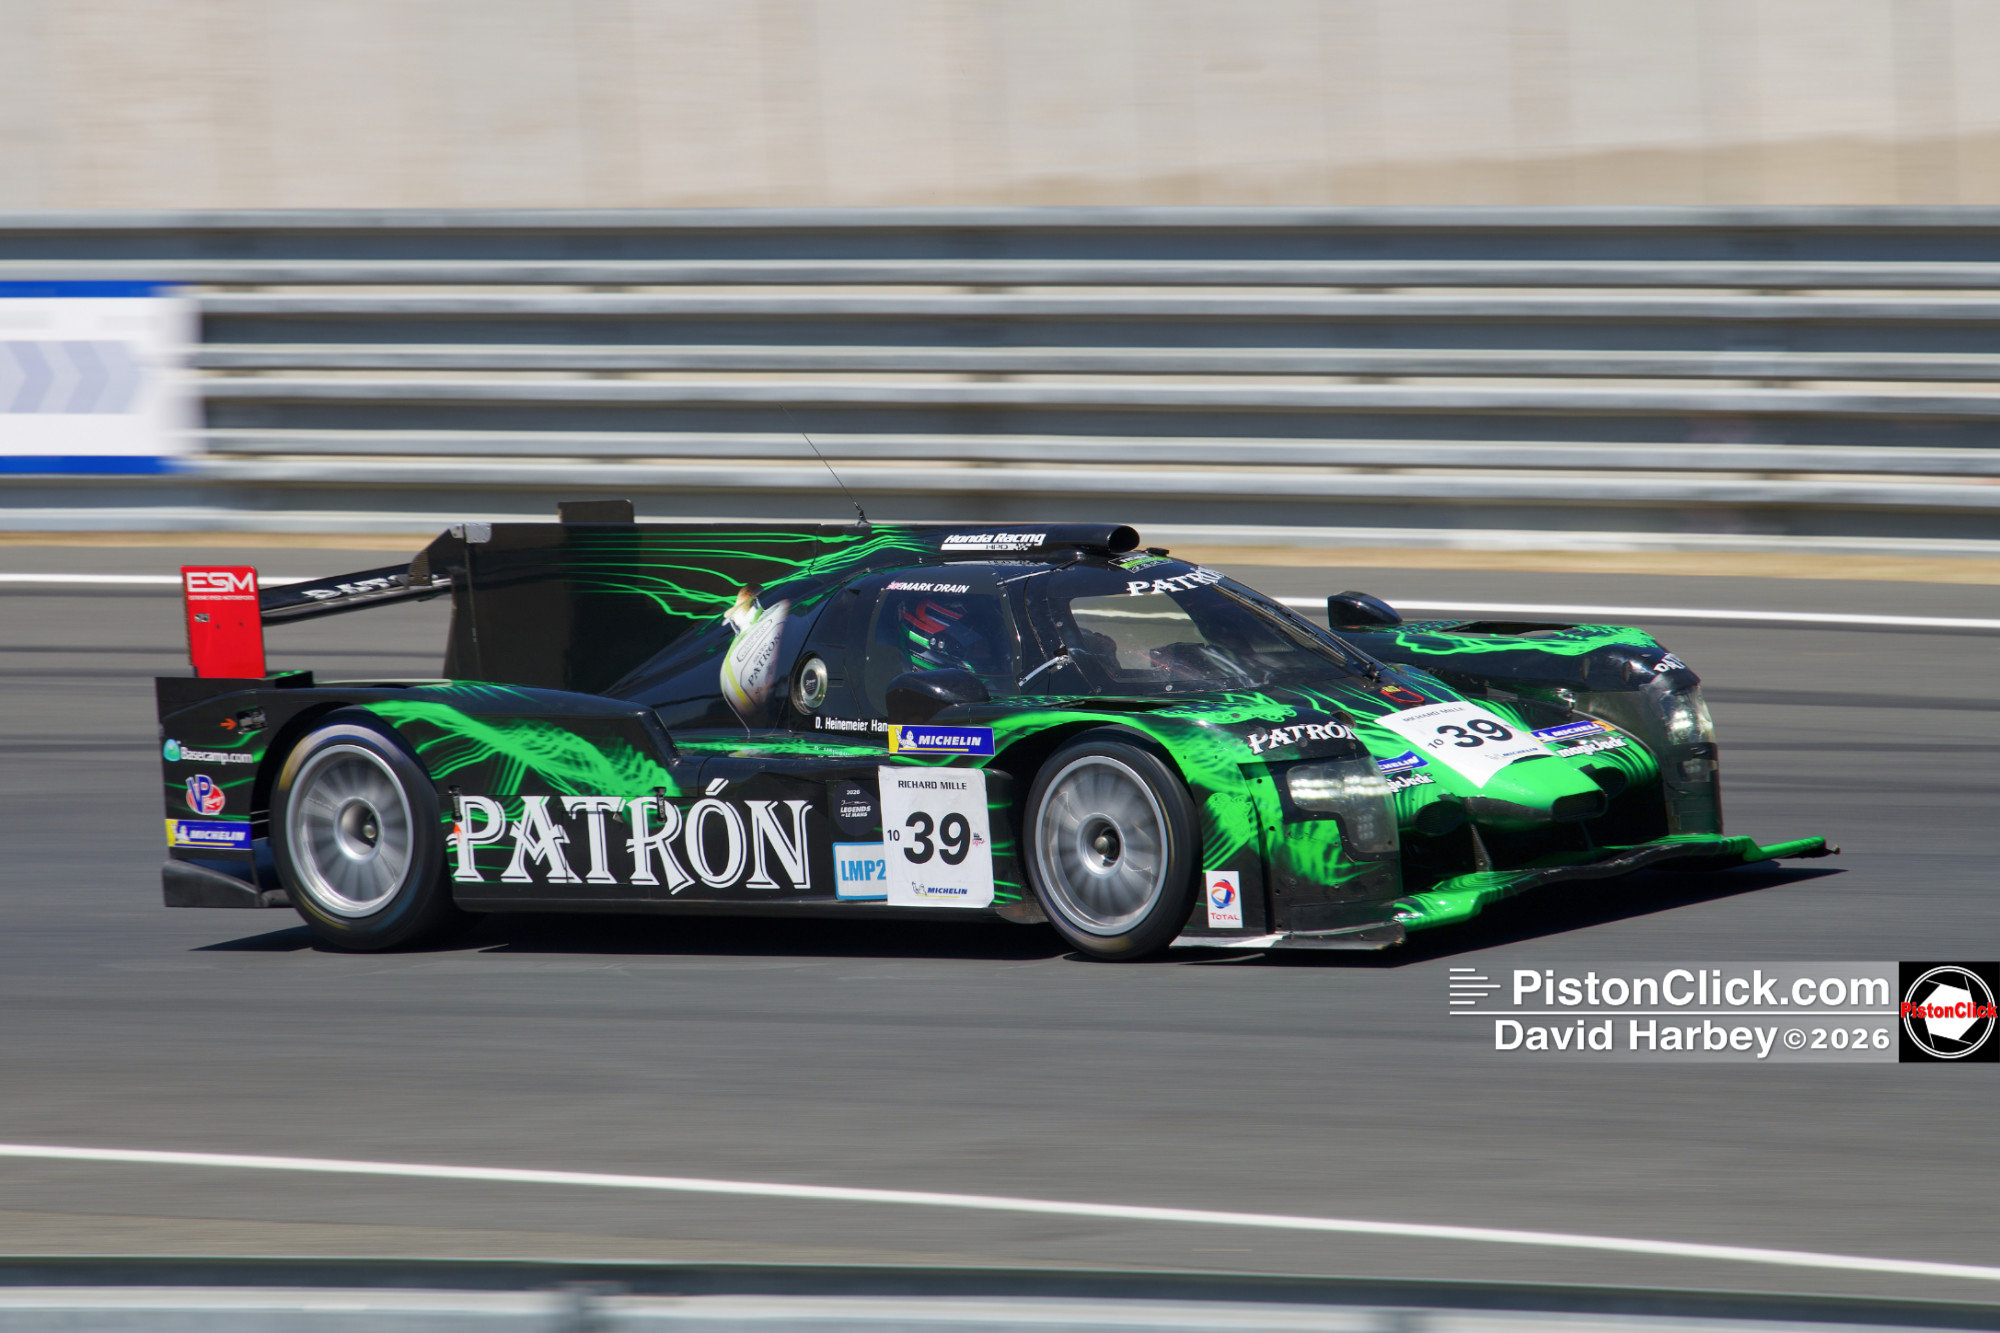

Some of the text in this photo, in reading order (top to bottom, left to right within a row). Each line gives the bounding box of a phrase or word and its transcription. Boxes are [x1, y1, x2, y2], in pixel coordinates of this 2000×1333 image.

[944, 533, 1046, 546] Honda Racing
[186, 572, 254, 592] ESM
[900, 582, 970, 594] MARK DRAIN
[815, 717, 889, 732] D. Heinemeier Han
[1550, 723, 1600, 737] MICHELI
[1437, 718, 1513, 748] 39
[918, 735, 982, 746] MICHELIN
[1427, 738, 1444, 749] 10
[180, 746, 253, 765] Basecamp.com
[898, 780, 967, 790] RICHARD MILLE
[190, 830, 246, 841] MICHELIN
[446, 778, 813, 895] PATRÓN
[887, 829, 900, 841] 10
[903, 811, 971, 866] 39
[841, 859, 886, 881] LMP2
[927, 887, 968, 895] MICHELIN
[1211, 912, 1240, 921] TOTAL
